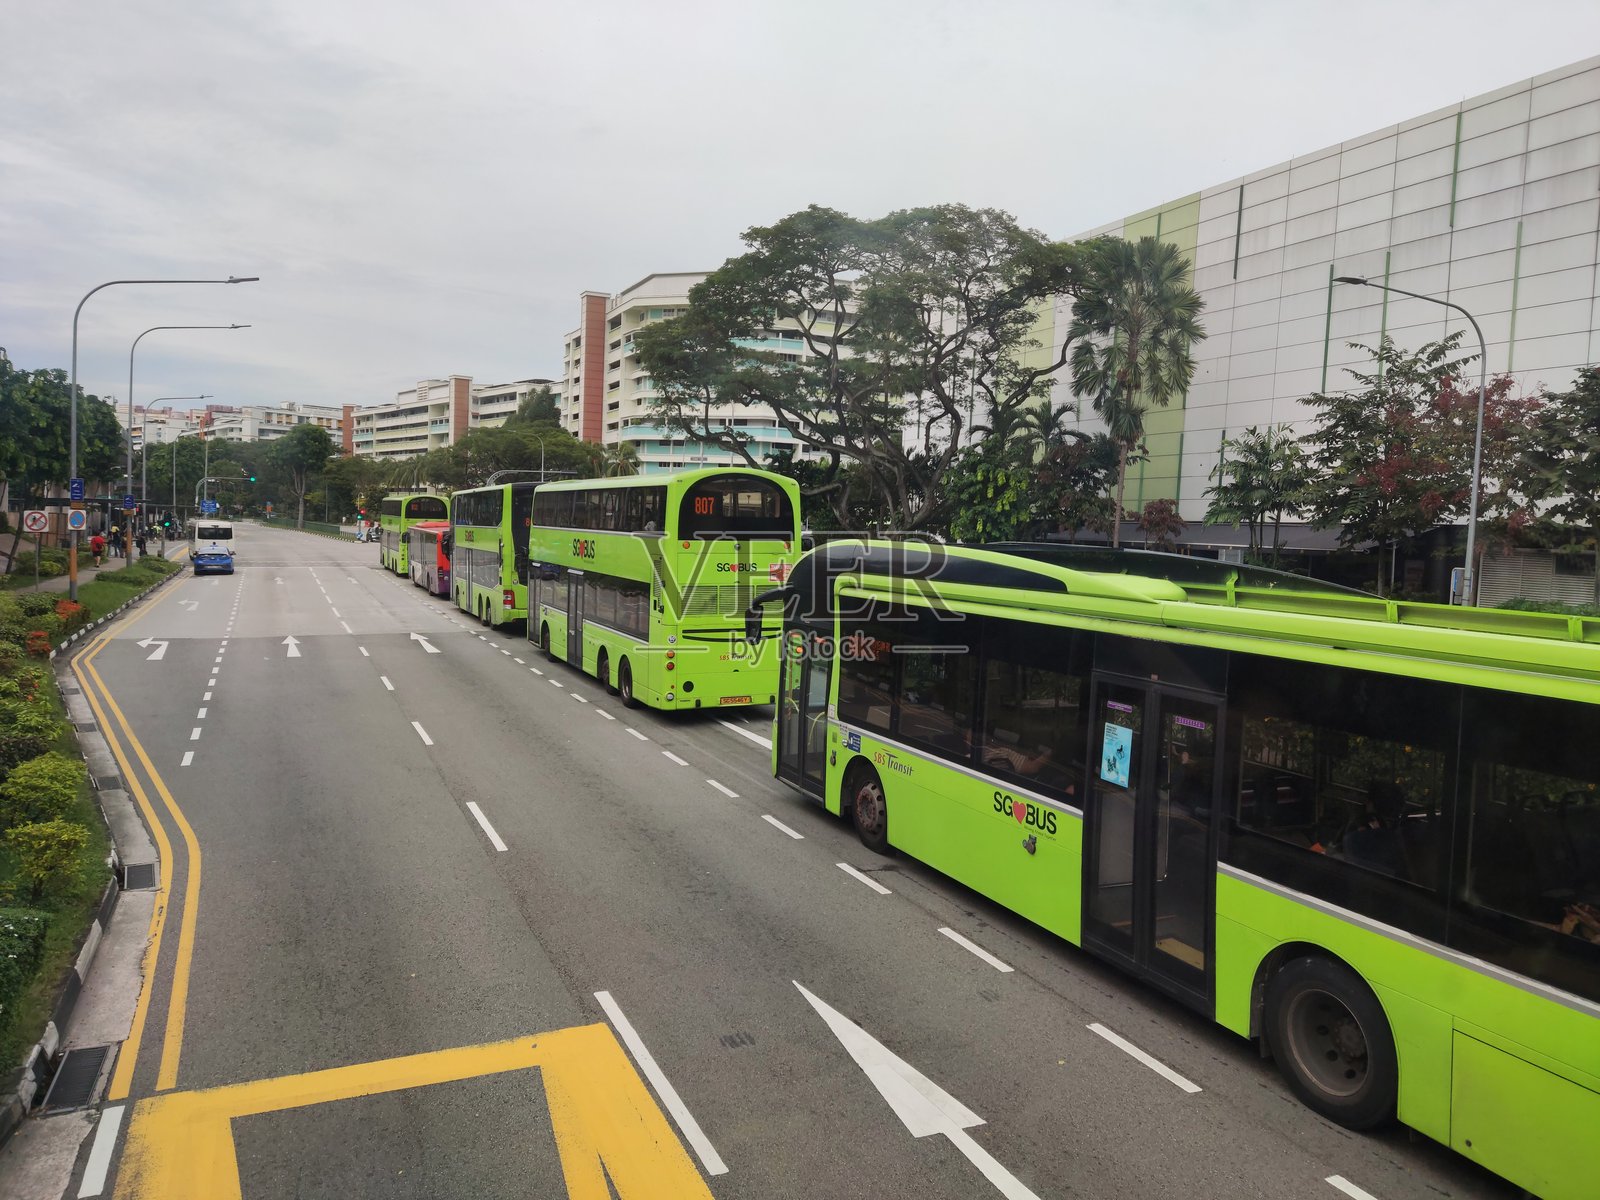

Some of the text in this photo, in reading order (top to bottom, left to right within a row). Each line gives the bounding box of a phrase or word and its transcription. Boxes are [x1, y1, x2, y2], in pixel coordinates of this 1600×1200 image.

[694, 496, 715, 514] 807
[874, 752, 915, 776] SBS Transit
